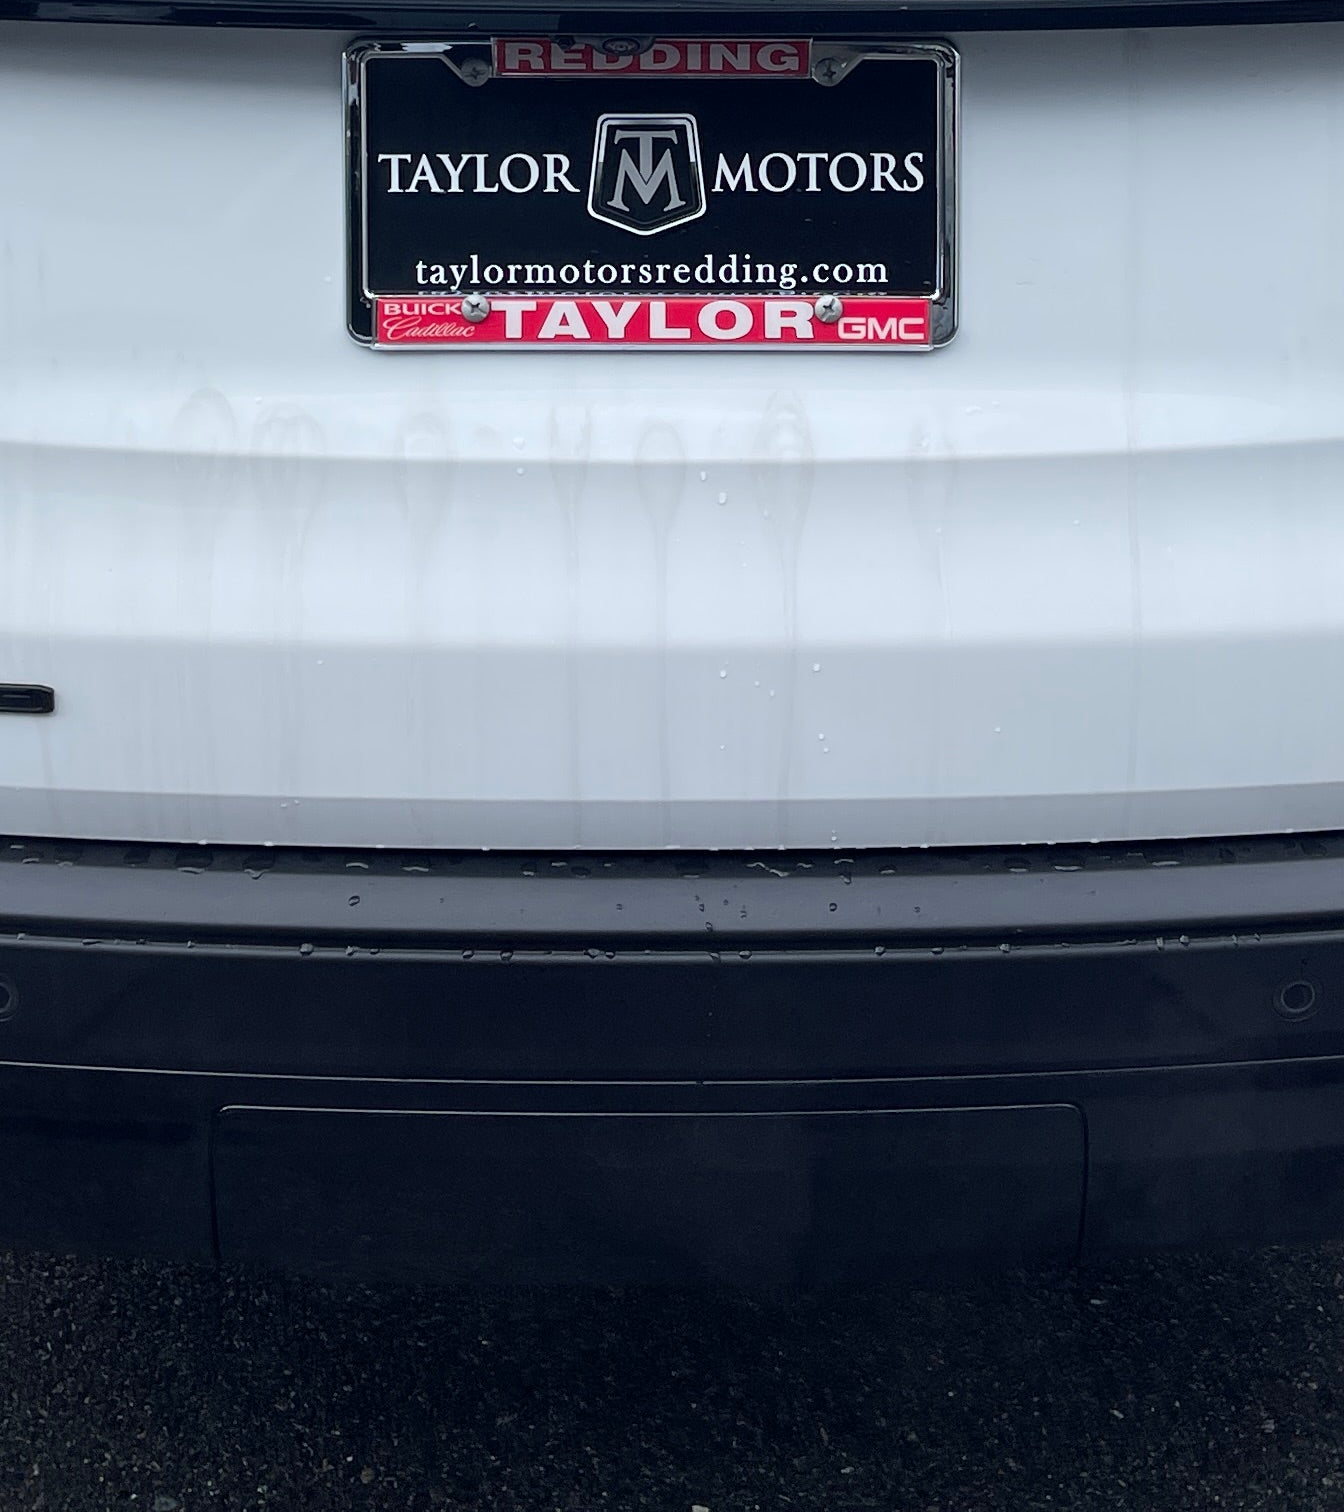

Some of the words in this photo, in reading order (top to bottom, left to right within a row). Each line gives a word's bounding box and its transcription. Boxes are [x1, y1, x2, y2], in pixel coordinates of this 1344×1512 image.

[505, 41, 800, 71] REDDING
[377, 152, 581, 194] TAYLOR
[711, 151, 926, 194] MOTORS
[414, 253, 889, 289] taylormotorsredding.com
[383, 303, 463, 316] BUICK
[490, 300, 815, 339] TAYLOR
[382, 315, 476, 341] Cadillac
[837, 316, 926, 340] GMC
